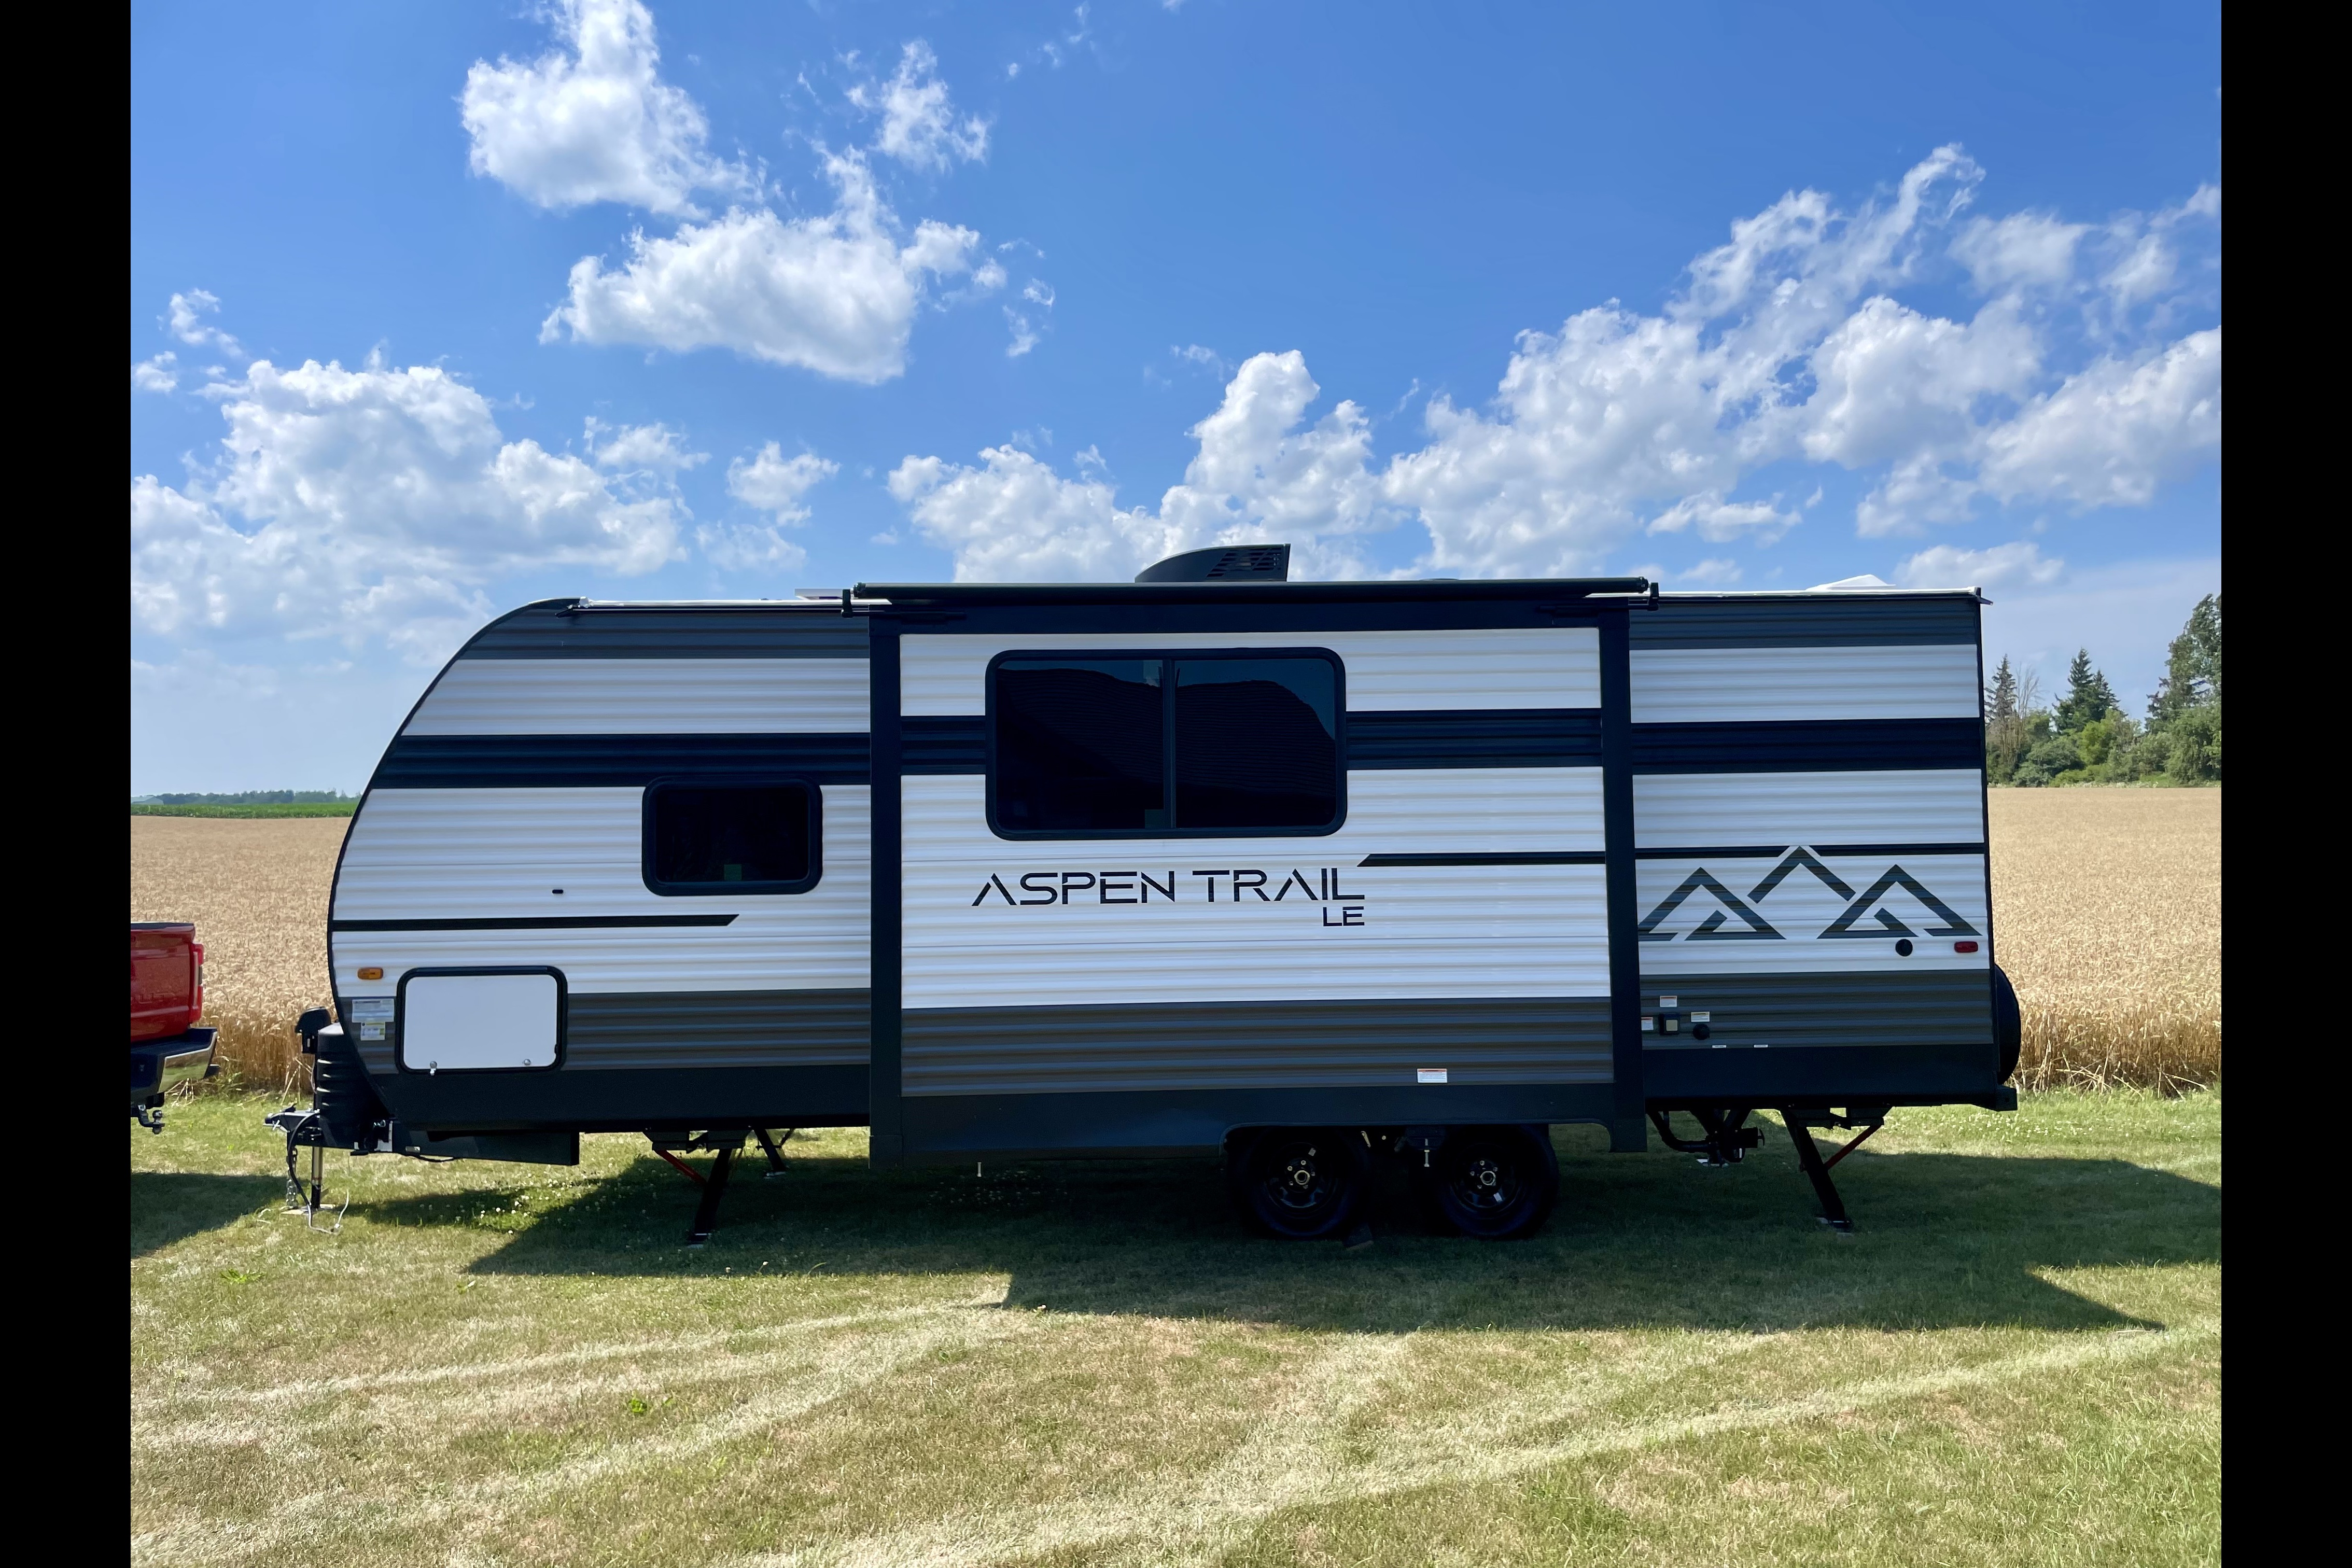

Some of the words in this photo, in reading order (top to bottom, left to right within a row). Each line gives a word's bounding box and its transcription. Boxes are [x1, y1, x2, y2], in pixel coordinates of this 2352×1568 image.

[971, 871, 1175, 906] ASPEN
[1192, 867, 1366, 902] TRAIL
[1323, 906, 1365, 927] LE
